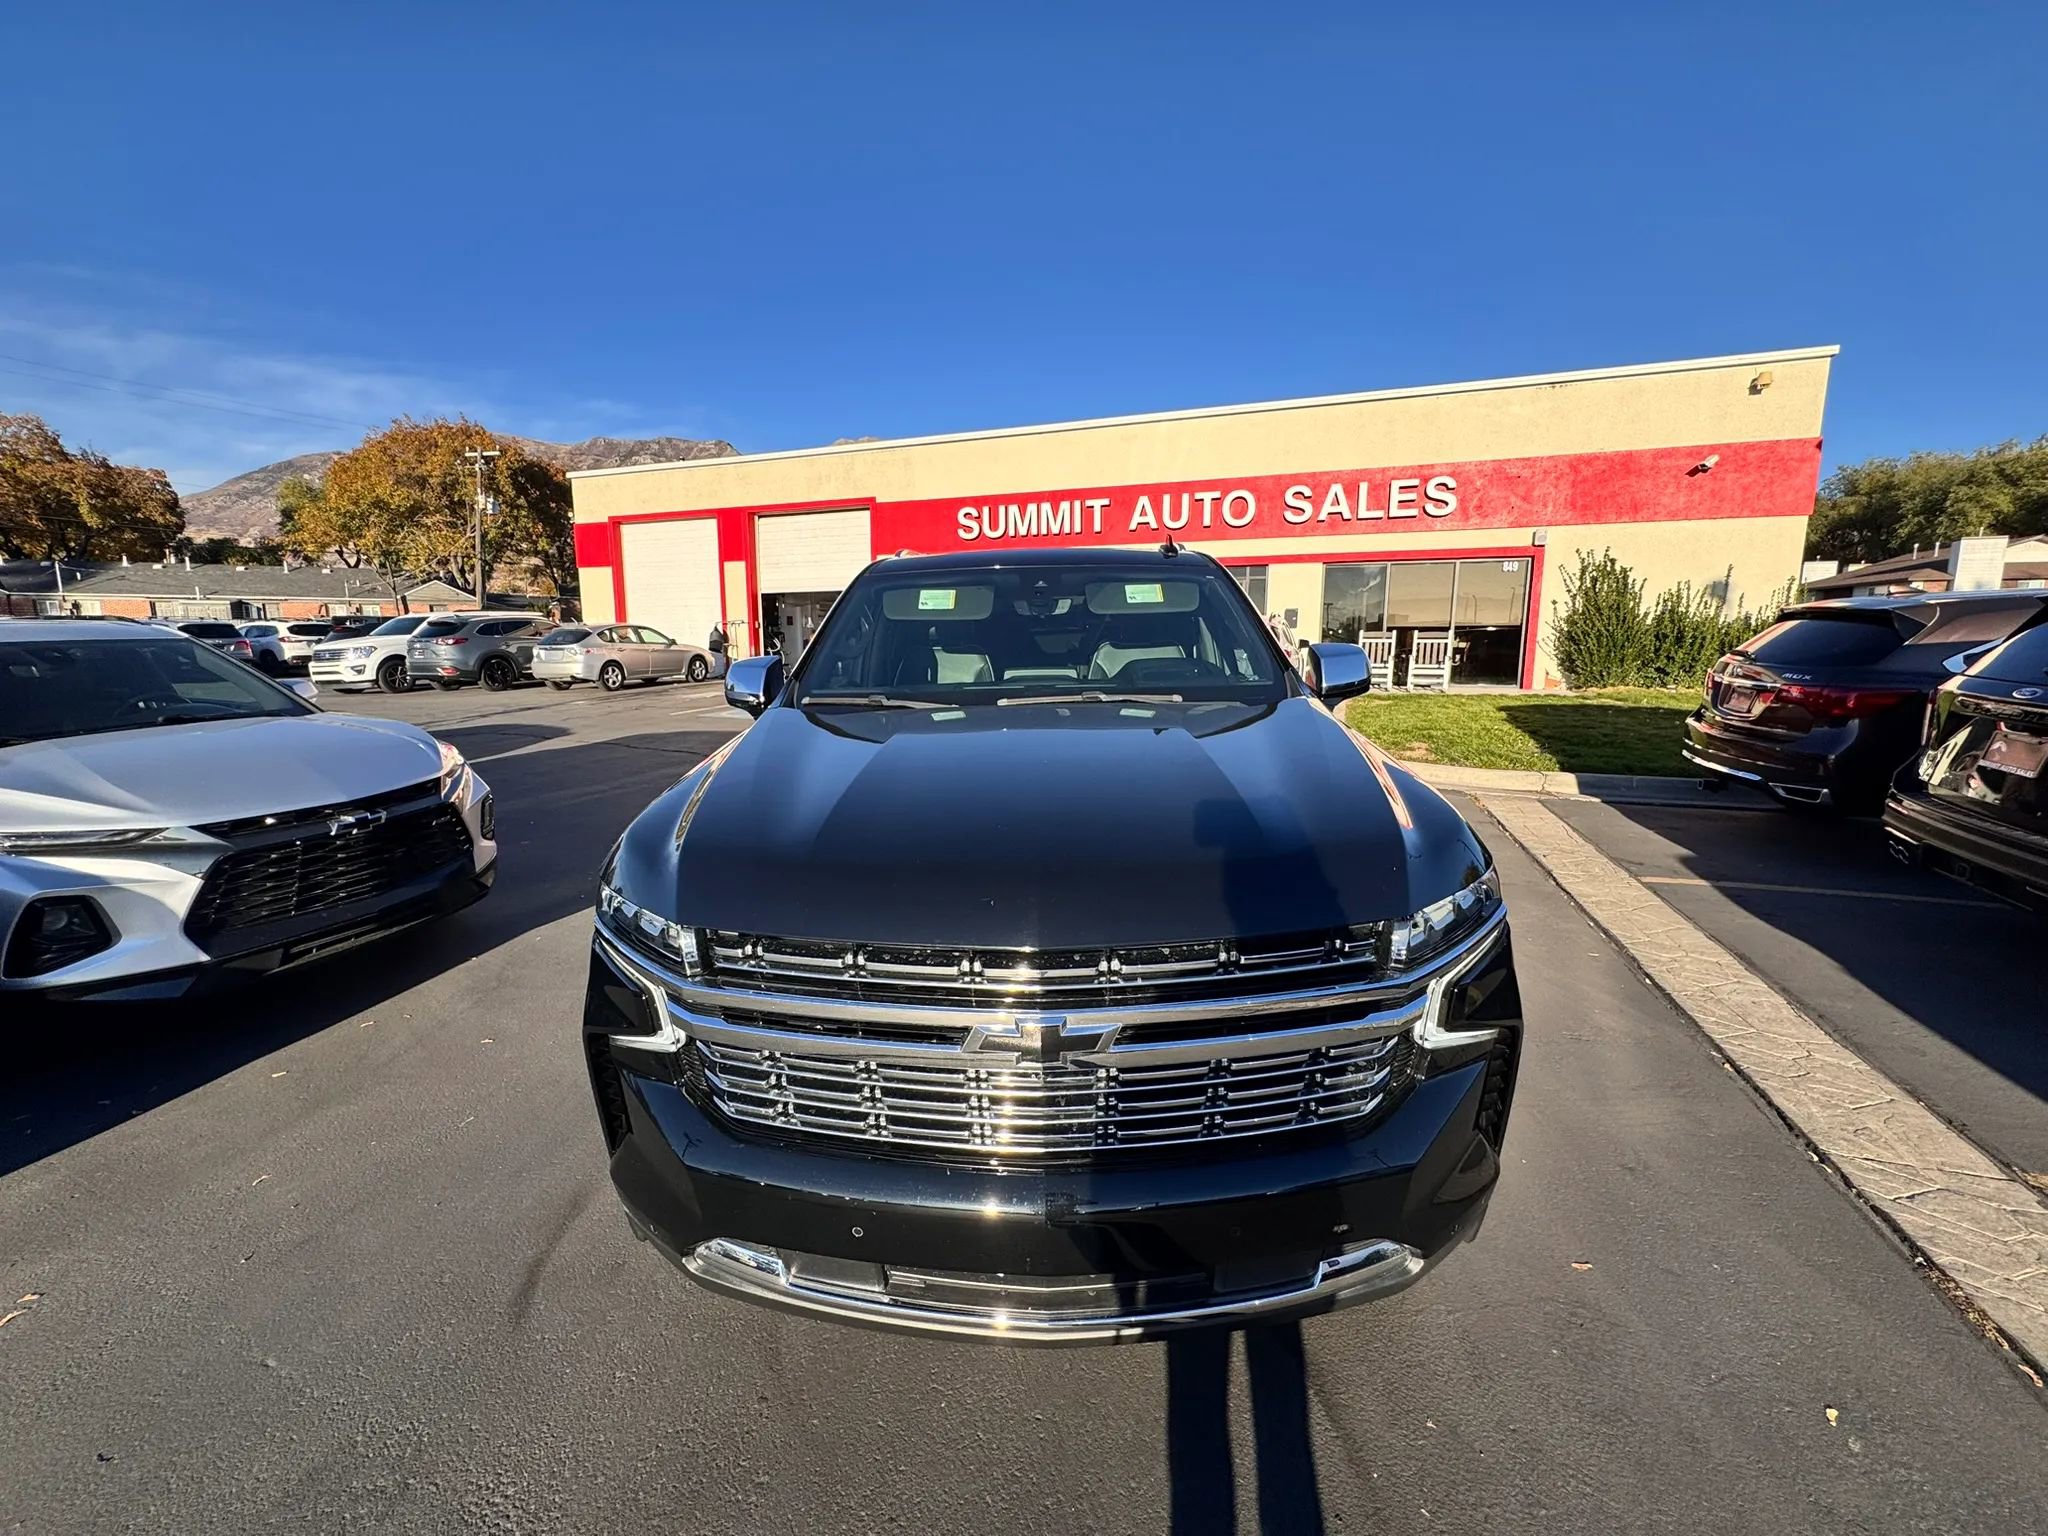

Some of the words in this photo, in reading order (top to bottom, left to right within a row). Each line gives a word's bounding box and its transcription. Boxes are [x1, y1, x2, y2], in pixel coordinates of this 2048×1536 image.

[957, 498, 1111, 540] SUMMIT
[1129, 489, 1257, 530] AUTO
[1283, 476, 1458, 524] SALES
